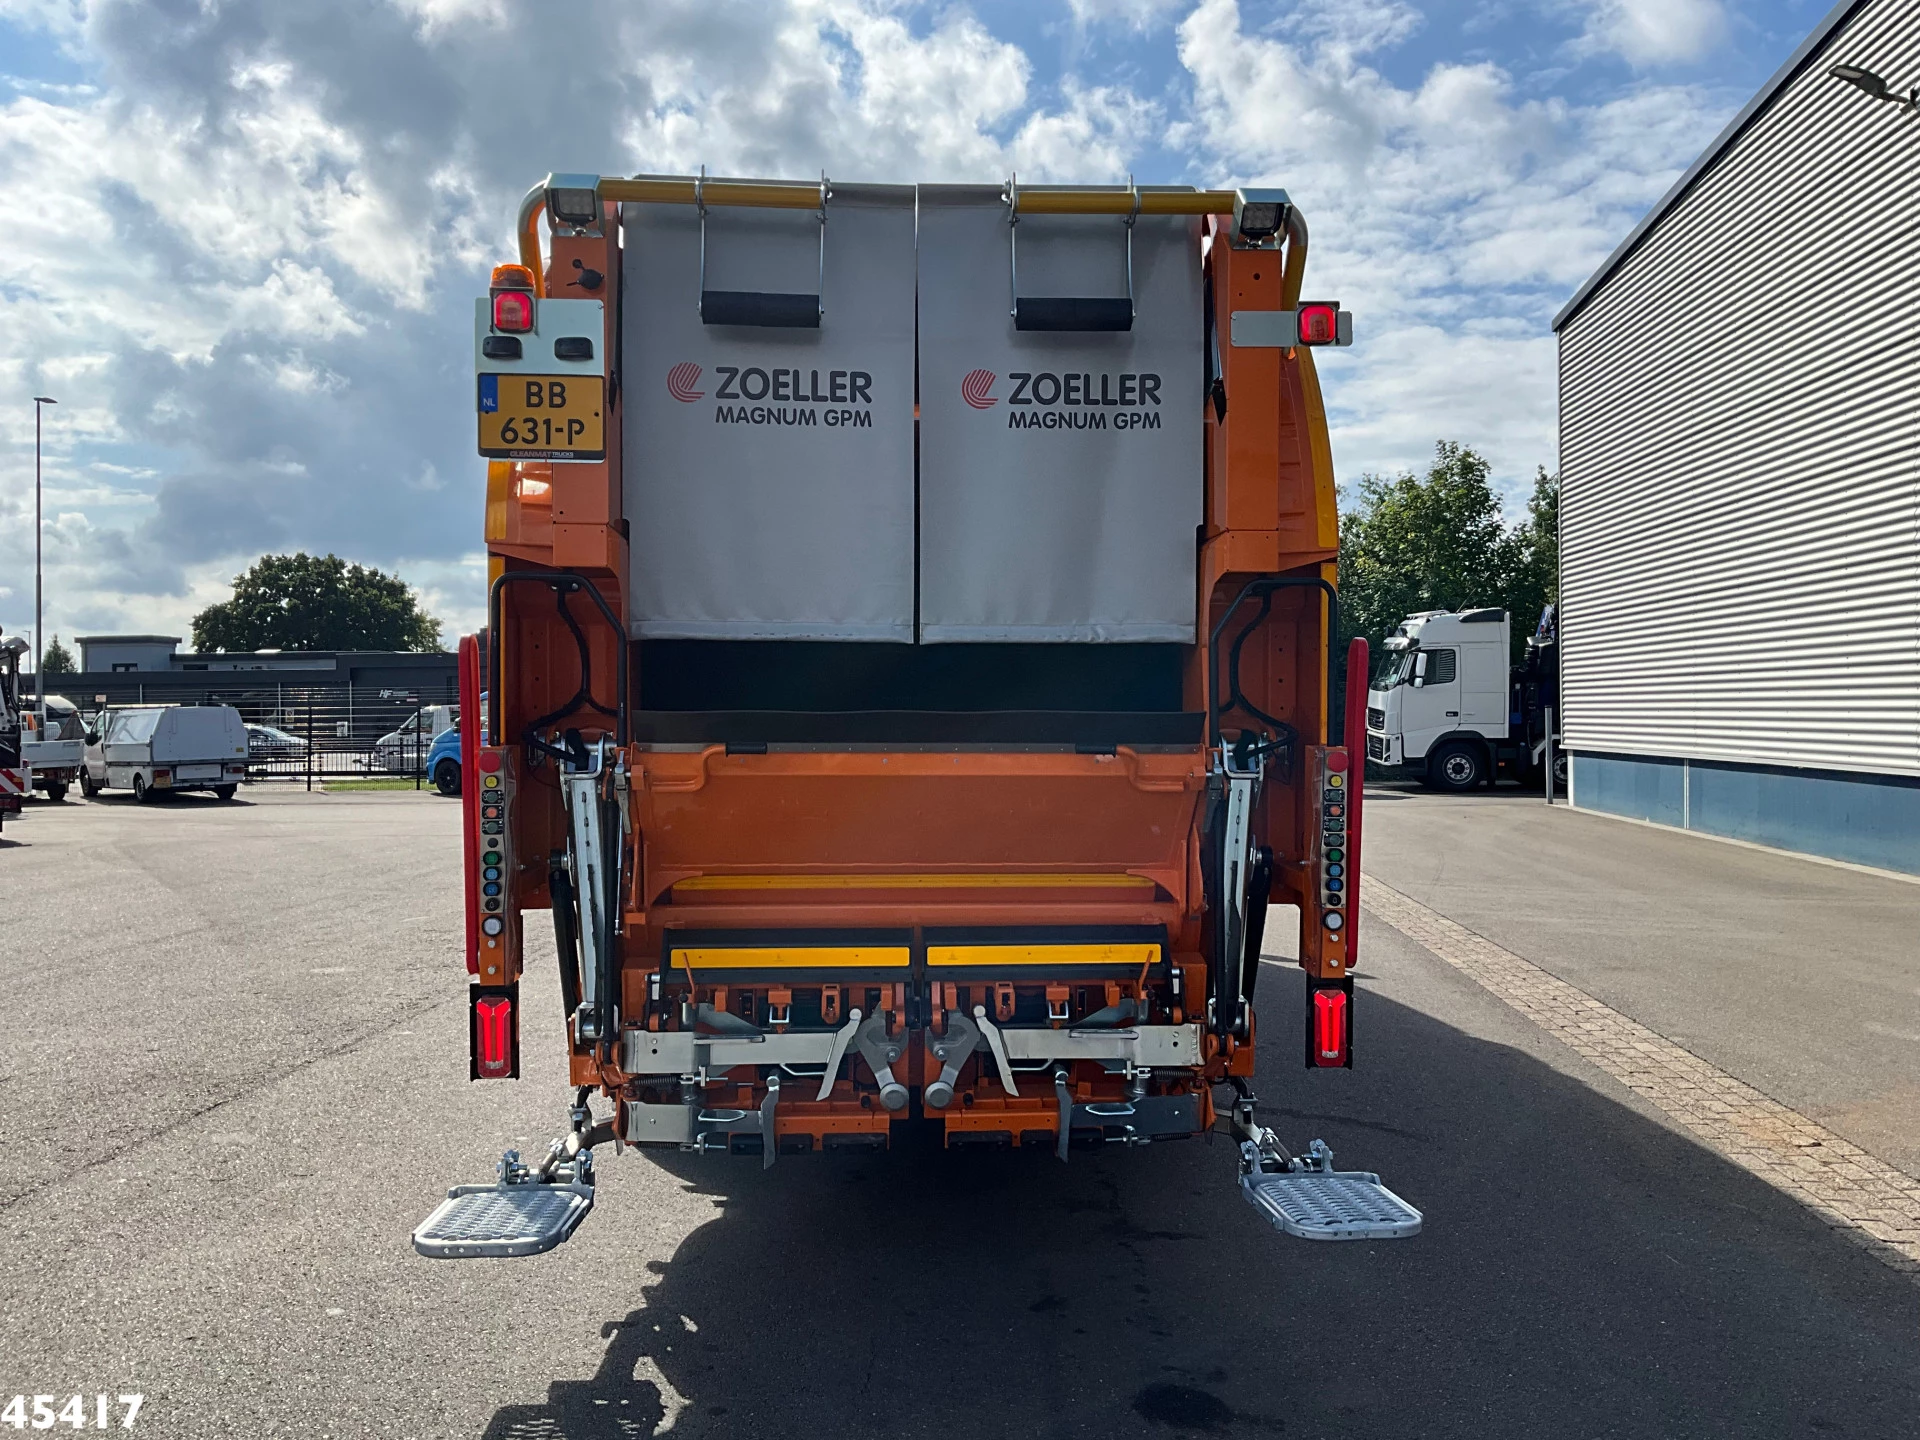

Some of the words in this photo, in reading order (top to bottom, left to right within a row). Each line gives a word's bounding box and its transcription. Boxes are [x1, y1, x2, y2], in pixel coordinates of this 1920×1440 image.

[526, 381, 567, 408] BB
[715, 366, 873, 403] ZOELLER
[1008, 372, 1162, 406] ZOELLER
[483, 398, 496, 407] NL
[715, 405, 818, 426] MAGNUM
[824, 409, 873, 428] GPM
[1008, 411, 1107, 430] MAGNUM
[1113, 412, 1162, 430] GPM
[500, 417, 585, 445] 631-P
